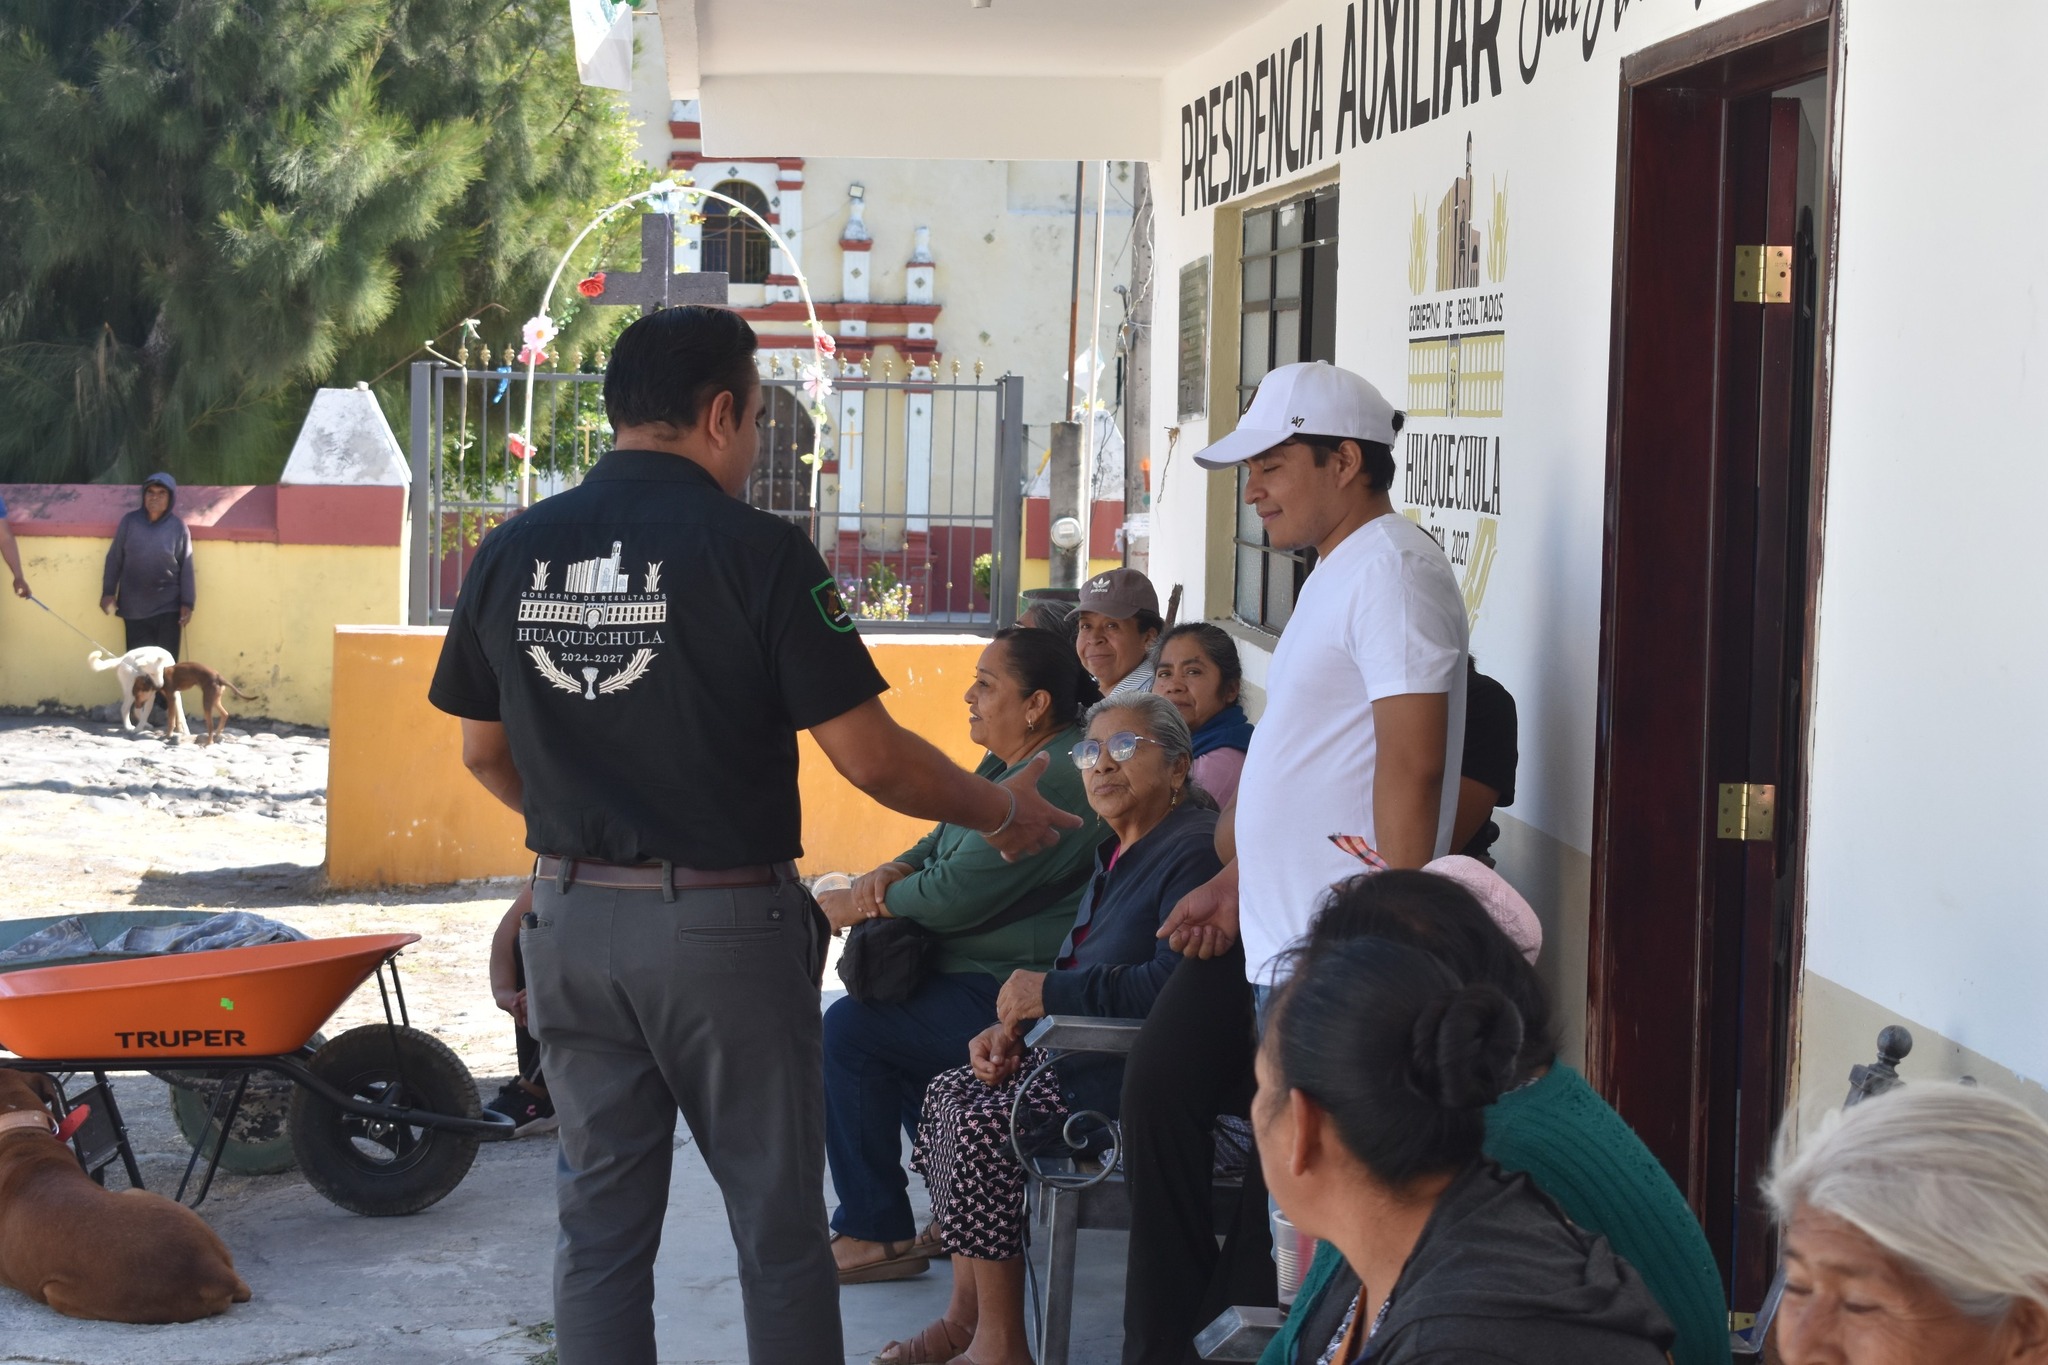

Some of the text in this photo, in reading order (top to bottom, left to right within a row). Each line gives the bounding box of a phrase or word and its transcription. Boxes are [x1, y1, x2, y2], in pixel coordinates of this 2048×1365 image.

[1181, 23, 1324, 217] PRESIDENCIA
[1335, 0, 1502, 155] AUXILIAR
[1409, 292, 1504, 332] GOBIERNO DE RESULTADOS
[1404, 432, 1501, 519] HUAQUECHULA
[1451, 529, 1470, 566] 2027
[521, 591, 578, 601] GOBIERNO
[601, 593, 668, 602] RESULTADOS
[517, 628, 665, 647] HUAQUECHULA
[561, 652, 624, 663] 2024-2027
[114, 1029, 247, 1049] TRUPER
